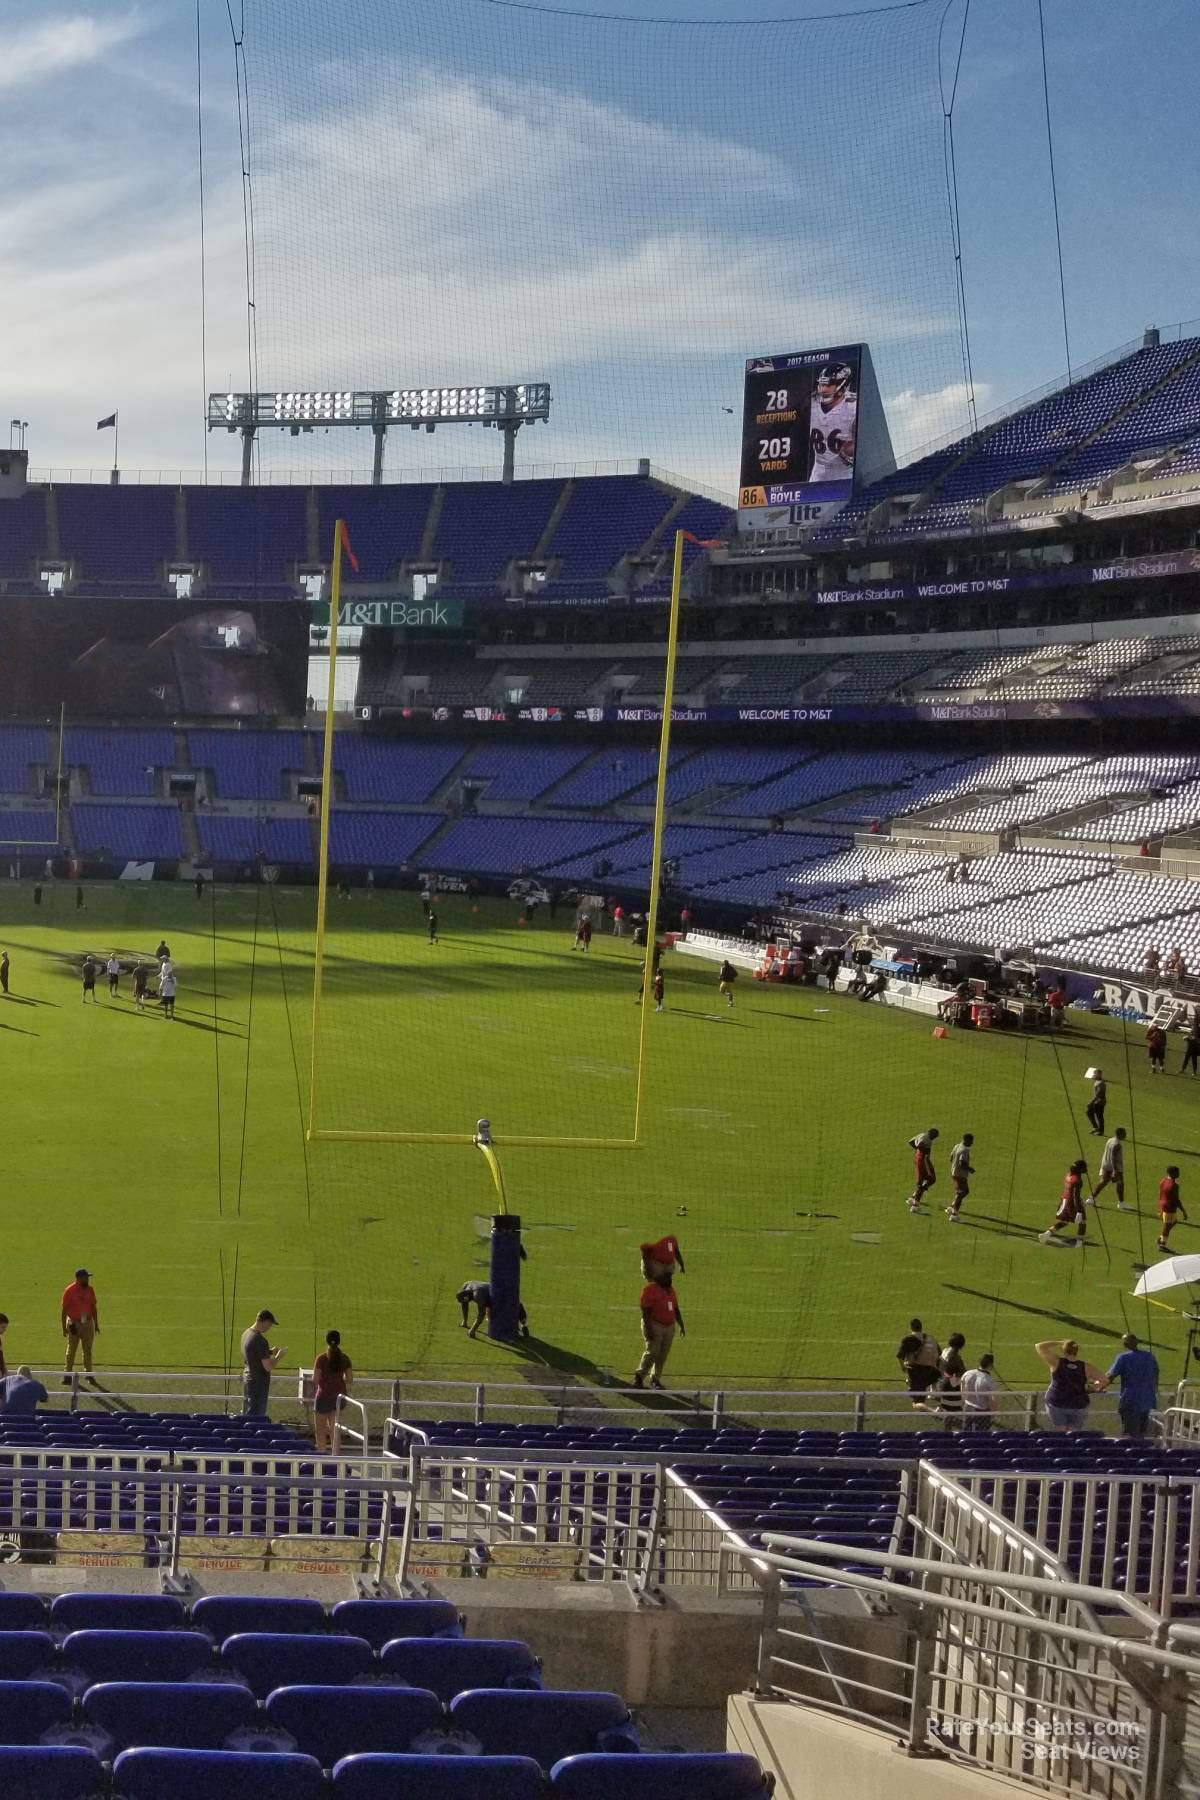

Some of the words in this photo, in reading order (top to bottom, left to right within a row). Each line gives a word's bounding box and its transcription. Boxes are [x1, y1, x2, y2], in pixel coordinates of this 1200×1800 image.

[787, 356, 803, 367] 2017
[804, 353, 830, 364] SEASON
[766, 389, 788, 411] 28
[756, 410, 797, 425] RECEPTIONS
[758, 437, 791, 460] 203
[761, 460, 788, 471] YARDS
[742, 488, 757, 505] 86
[770, 491, 801, 503] BOYLE
[788, 505, 822, 525] Lite
[1092, 567, 1115, 581] M&T
[1115, 565, 1137, 579] Bank
[1137, 561, 1177, 577] Stadium
[918, 582, 968, 597] WELCOME
[970, 581, 985, 593] TO
[987, 578, 1010, 592] M&T
[816, 591, 841, 603] M&T
[841, 589, 864, 601] Bank
[865, 588, 904, 601] Stadium
[328, 602, 389, 625] M&T
[390, 603, 448, 625] Bank
[617, 710, 643, 720] M&T
[669, 709, 707, 720] Stadium
[739, 709, 790, 720] WELCOME
[792, 709, 807, 720] TO
[809, 709, 832, 720] M&T
[931, 706, 952, 719] M&T
[952, 706, 973, 718] Bank
[973, 705, 1006, 719] Stadium
[8, 1532, 21, 1546] MIA
[199, 1560, 241, 1569] SERVICE
[297, 1562, 341, 1572] SERVICE
